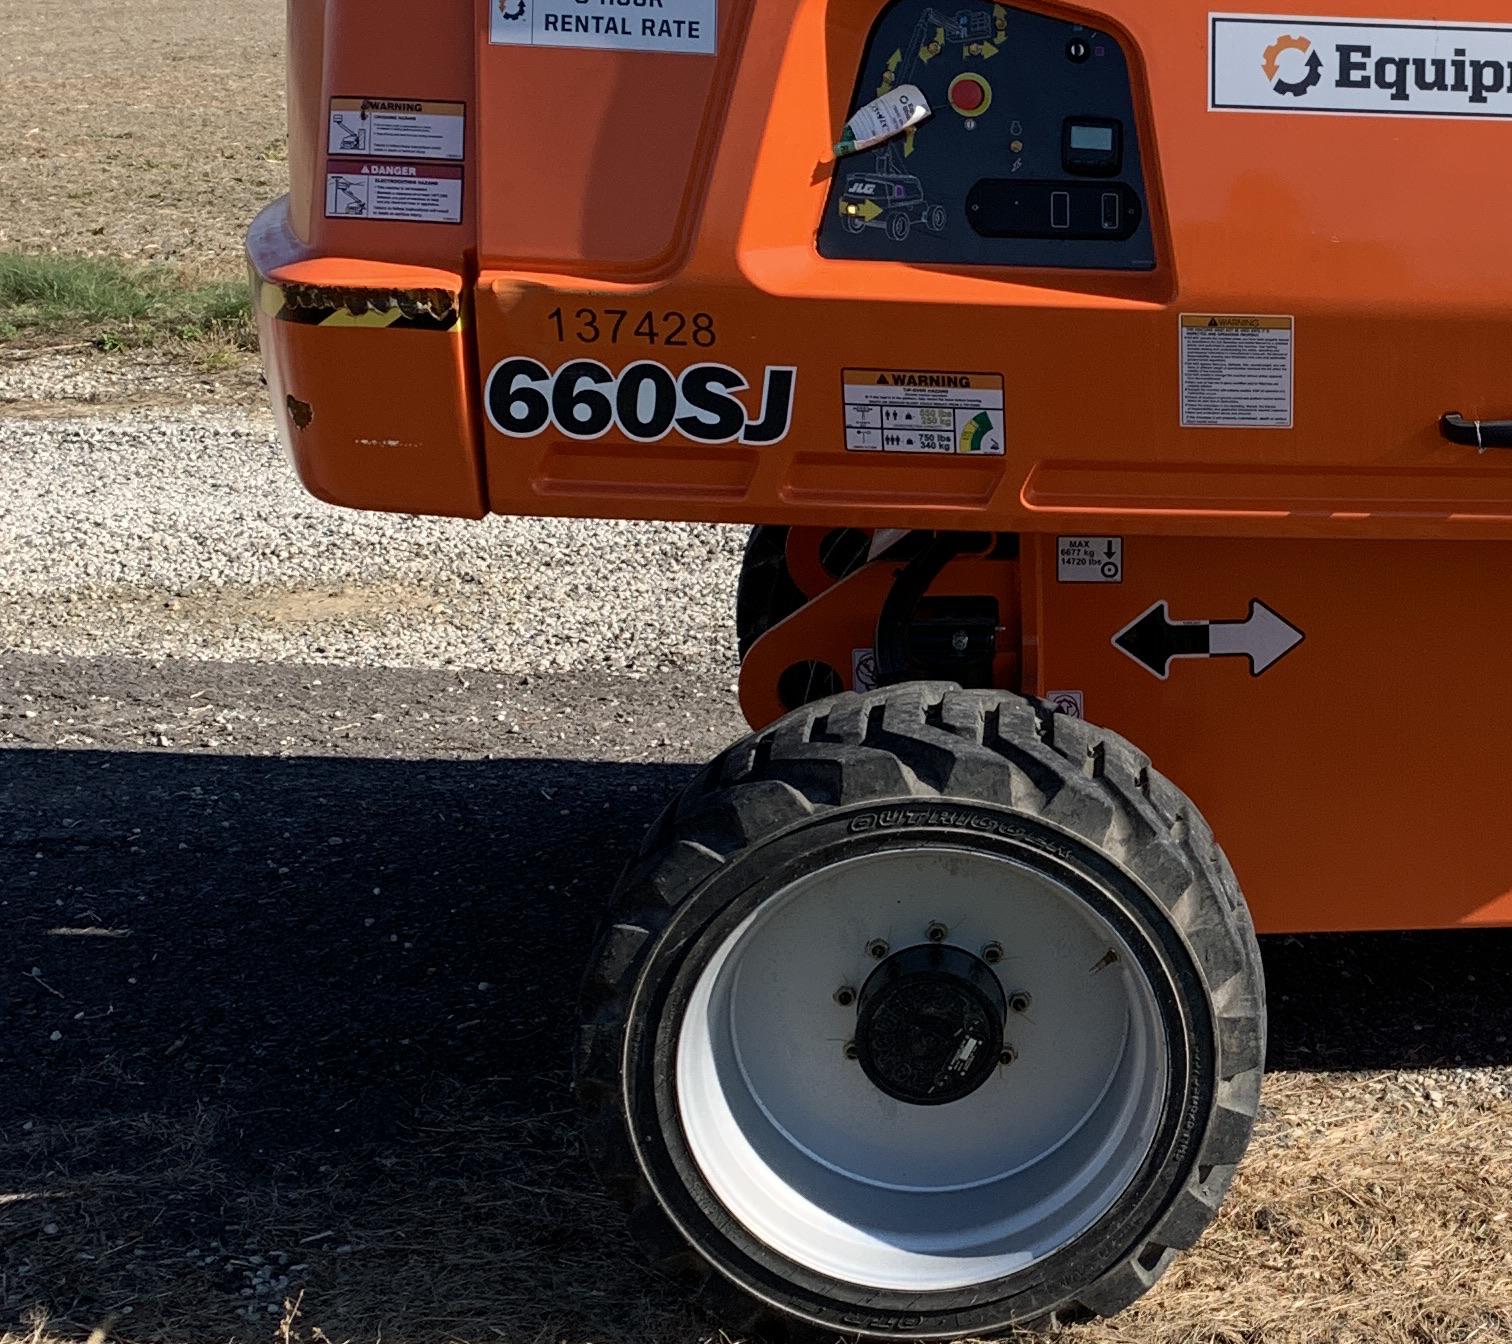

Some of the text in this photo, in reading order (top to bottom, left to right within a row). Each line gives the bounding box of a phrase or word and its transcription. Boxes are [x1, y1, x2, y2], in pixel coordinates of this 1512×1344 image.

[544, 13, 700, 39] RENTAL RATE
[370, 101, 423, 112] WARNING
[371, 165, 417, 176] DANGER
[848, 182, 876, 195] JLG
[548, 307, 717, 348] 137428
[892, 373, 971, 388] WARNING
[485, 357, 797, 446] 660SJ
[918, 433, 935, 442] 750
[920, 441, 950, 451] 340 kg
[1069, 540, 1090, 548] MAX
[1061, 548, 1095, 558] 6677 kg
[1061, 557, 1102, 566] 14720 lbs
